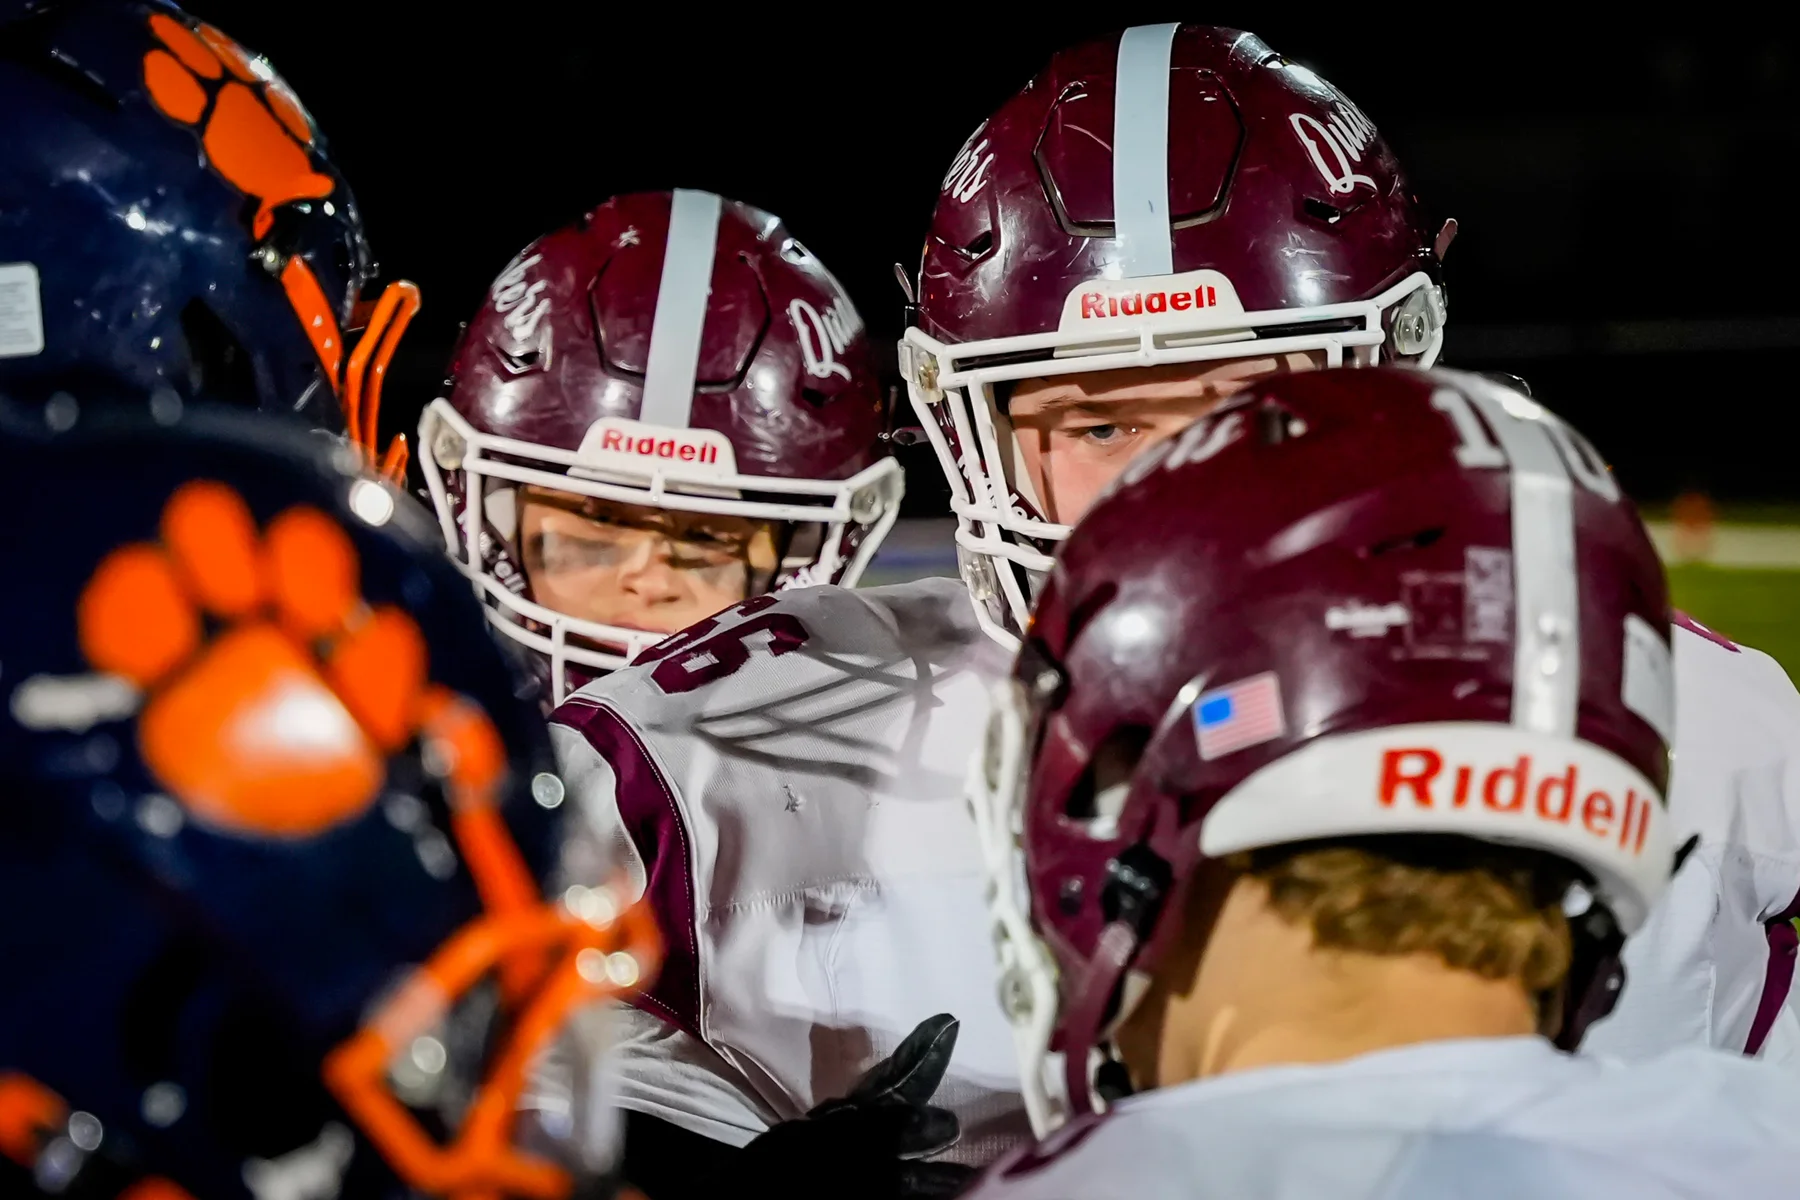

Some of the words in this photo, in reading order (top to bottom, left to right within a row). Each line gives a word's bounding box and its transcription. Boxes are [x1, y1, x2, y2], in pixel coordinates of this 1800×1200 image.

[1081, 284, 1217, 319] Riddell
[602, 429, 719, 464] Riddell
[1377, 746, 1651, 855] Riddell
